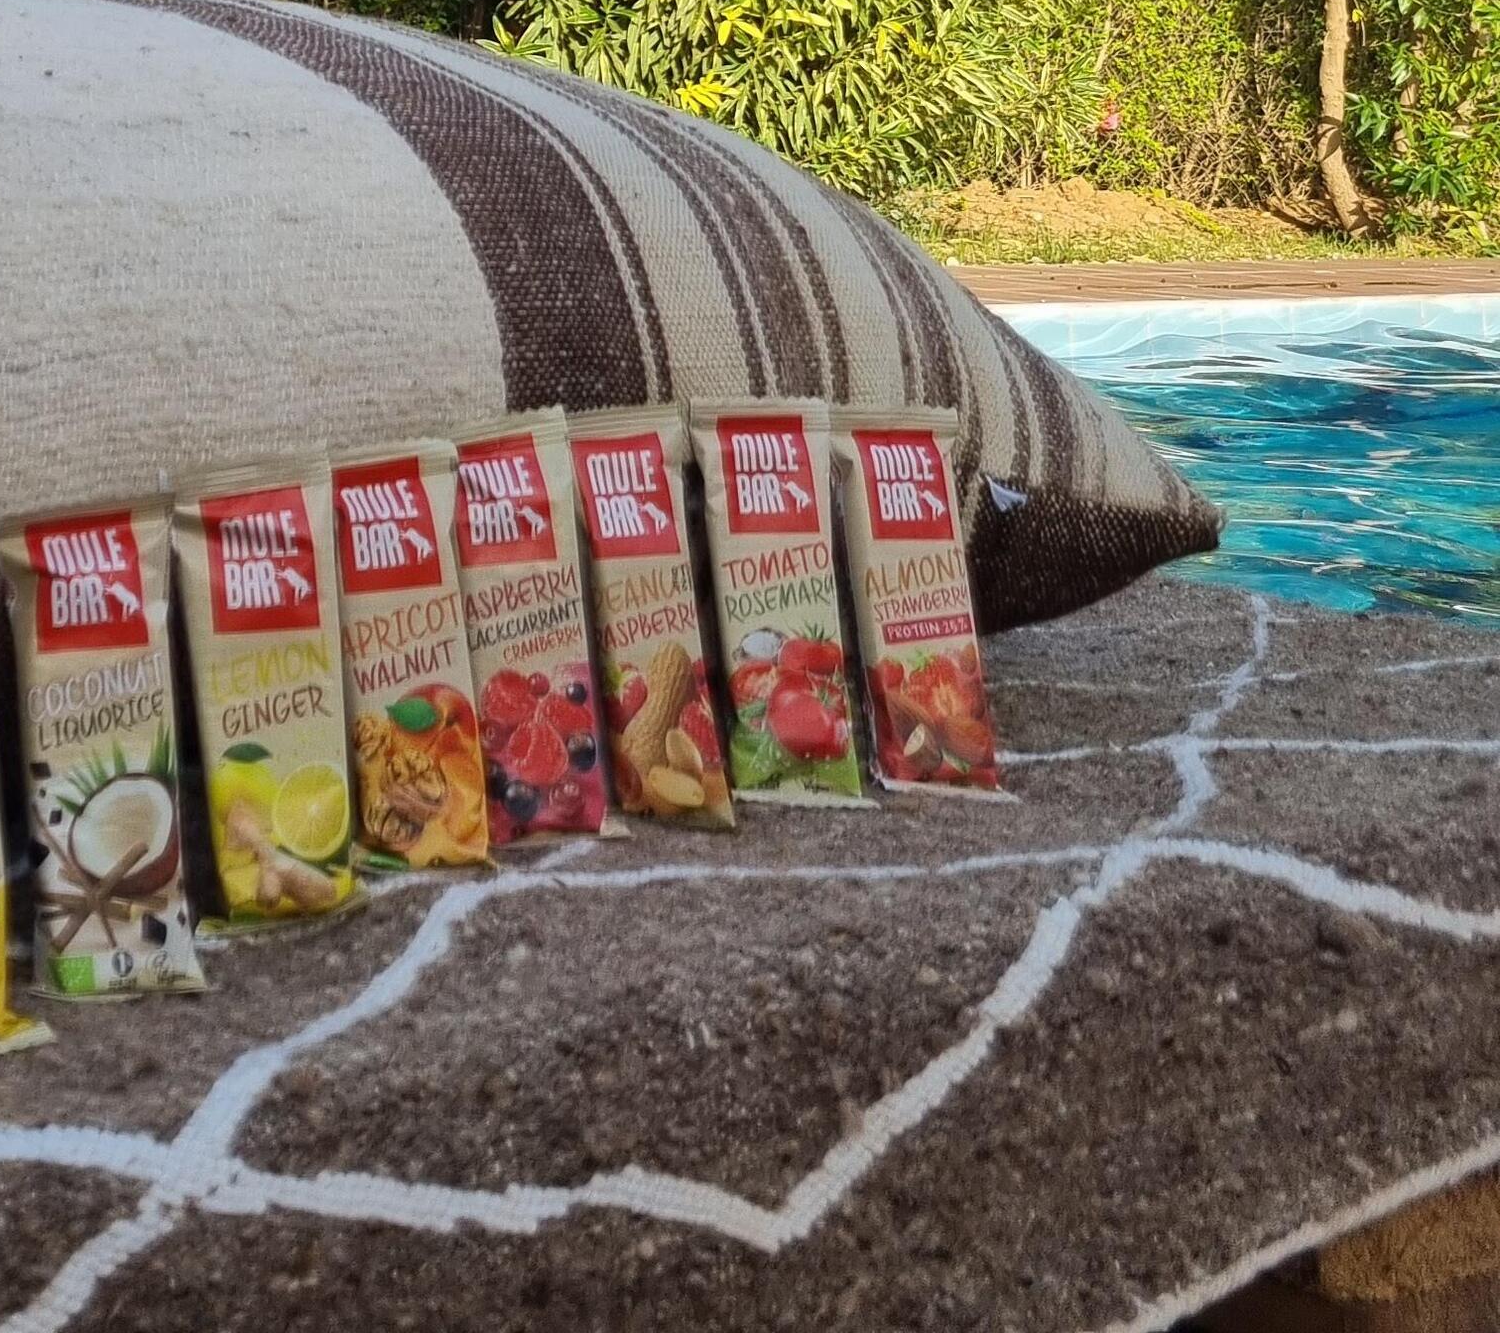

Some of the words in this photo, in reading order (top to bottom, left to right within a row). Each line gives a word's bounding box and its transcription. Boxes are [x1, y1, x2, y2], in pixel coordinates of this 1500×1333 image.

[586, 449, 657, 496] MULE
[731, 433, 799, 473] MULE
[869, 443, 934, 482] MULE
[340, 478, 419, 523] MULE
[459, 456, 533, 501] MULE
[736, 473, 785, 515] BAR
[876, 481, 923, 522] BAR
[219, 509, 298, 560] MULE
[468, 499, 519, 547] BAR
[595, 494, 645, 539] BAR
[42, 528, 126, 576] MULE
[351, 521, 405, 572] BAR
[721, 541, 830, 590] TOMATO
[51, 574, 108, 628] BAR
[223, 558, 281, 610] BAR
[464, 563, 578, 621] ASPBERRY
[723, 573, 834, 624] ROSEMARY
[873, 584, 969, 622] STRAWBERRY
[342, 593, 460, 663] APRICOT
[467, 598, 580, 652] LACKCURRANT
[503, 624, 583, 664] CRANBERRY
[887, 621, 941, 640] PROTEIN
[942, 617, 968, 634] 25%
[27, 653, 163, 723] COCONUT
[209, 634, 331, 705] LEMON
[352, 639, 456, 696] WALNUT
[37, 688, 165, 752] LIQUORICE
[222, 683, 332, 739] GINGER
